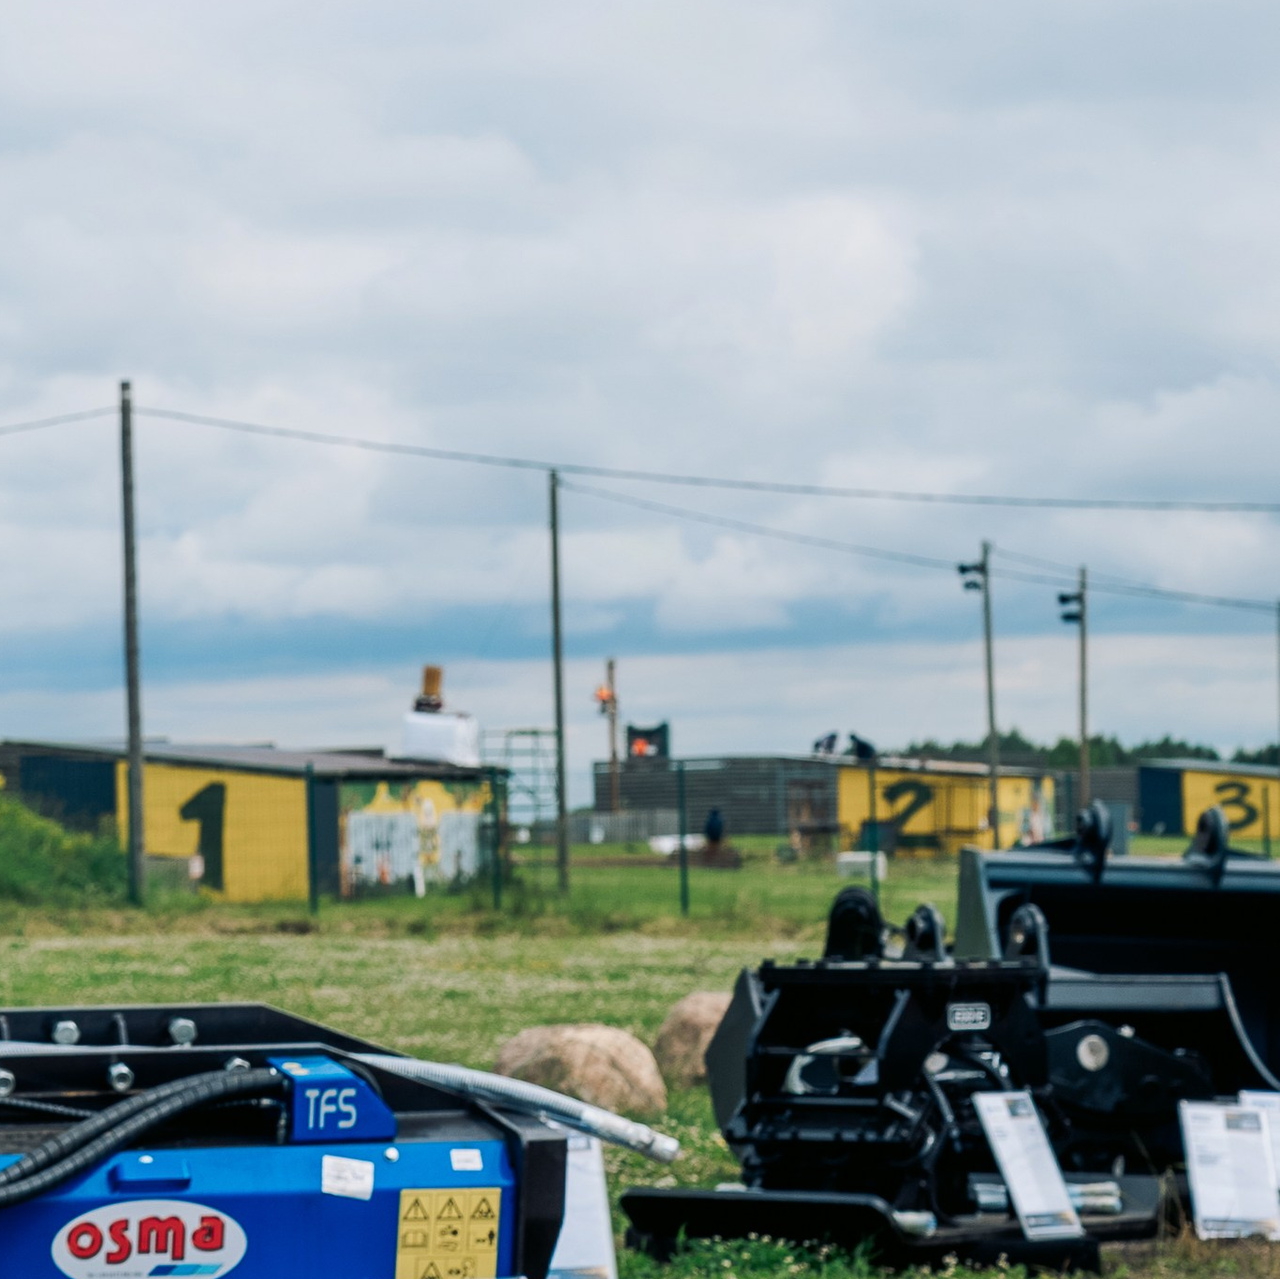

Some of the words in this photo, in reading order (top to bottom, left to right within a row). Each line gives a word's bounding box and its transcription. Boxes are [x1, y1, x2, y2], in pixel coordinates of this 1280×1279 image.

[883, 780, 939, 848] 2
[1215, 782, 1258, 831] 3
[179, 781, 227, 891] 1
[305, 1088, 357, 1129] TFS
[67, 1216, 225, 1265] osma
